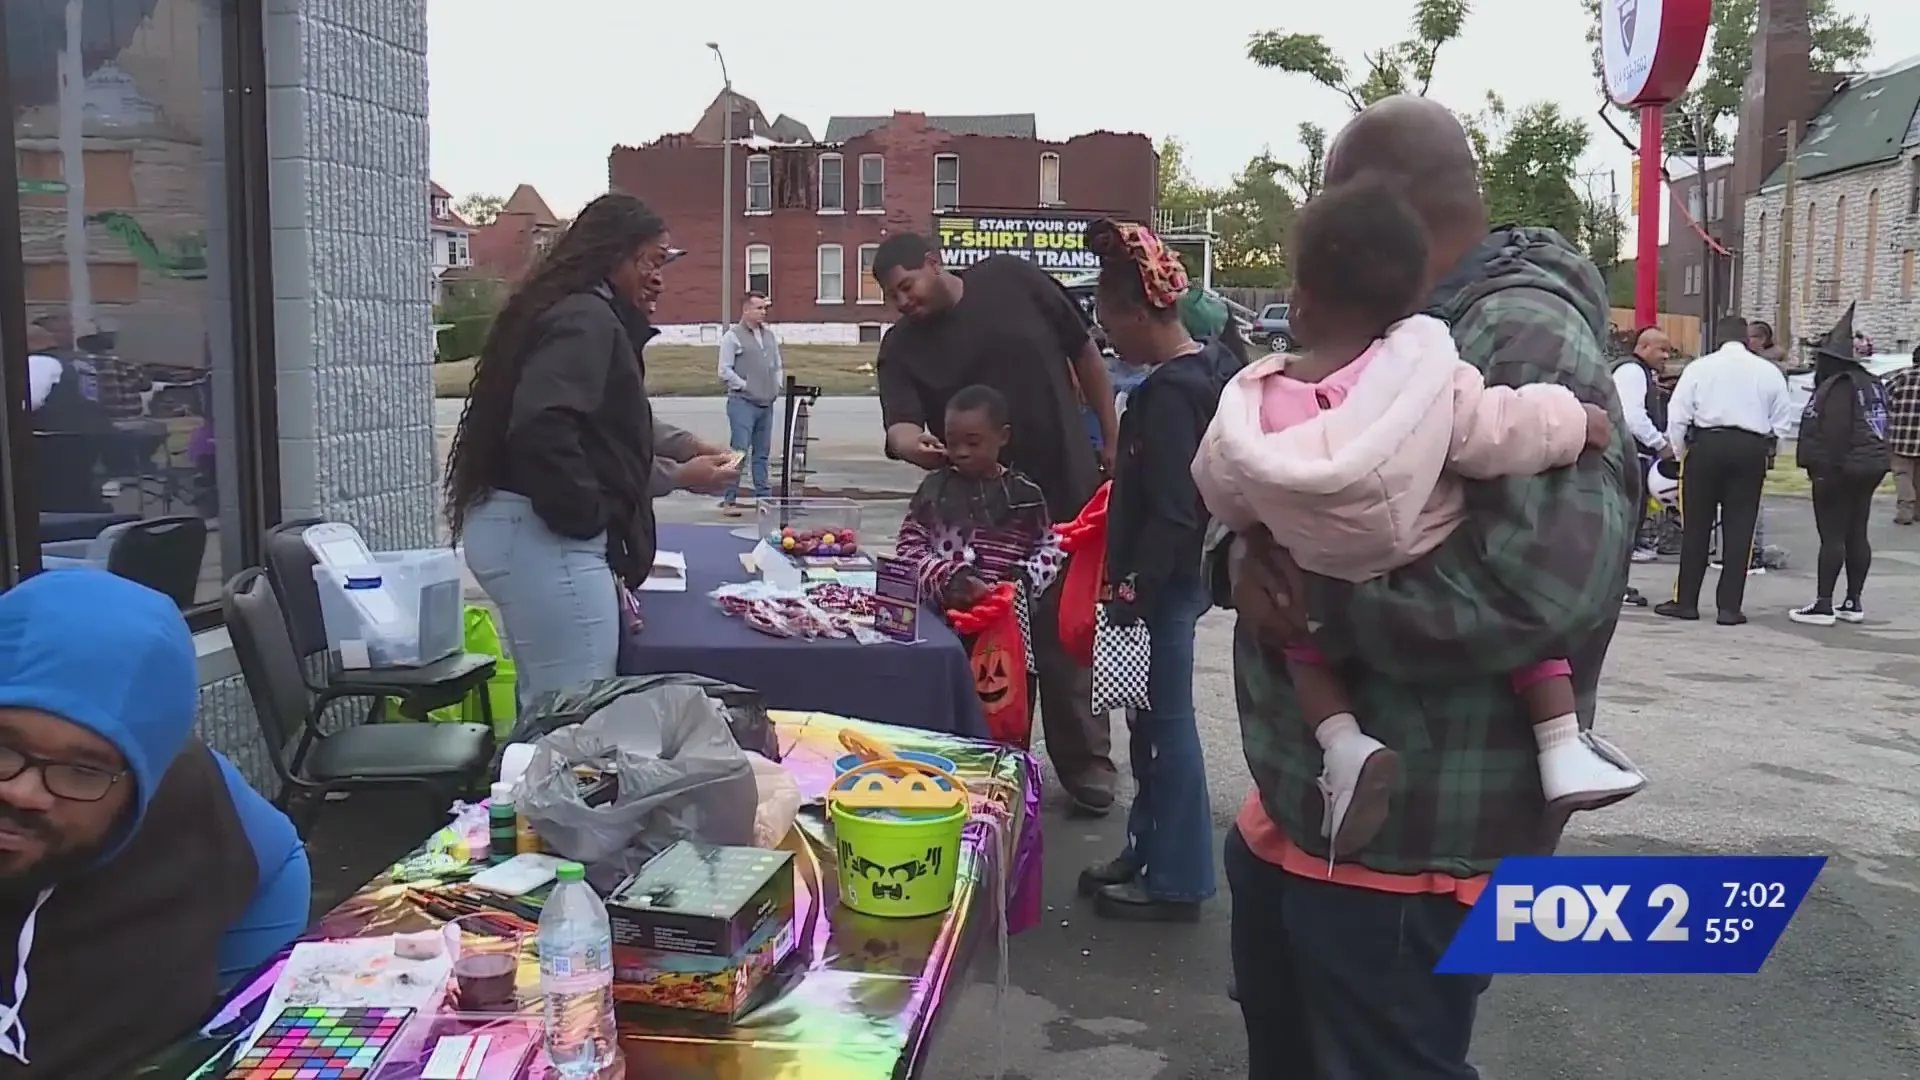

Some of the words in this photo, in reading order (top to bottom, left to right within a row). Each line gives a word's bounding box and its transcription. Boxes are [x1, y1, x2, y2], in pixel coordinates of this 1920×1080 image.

[979, 219, 1023, 231] START
[1026, 219, 1064, 231] YOUR
[939, 230, 1028, 248] T-SHIRT
[1033, 232, 1085, 249] BUSI
